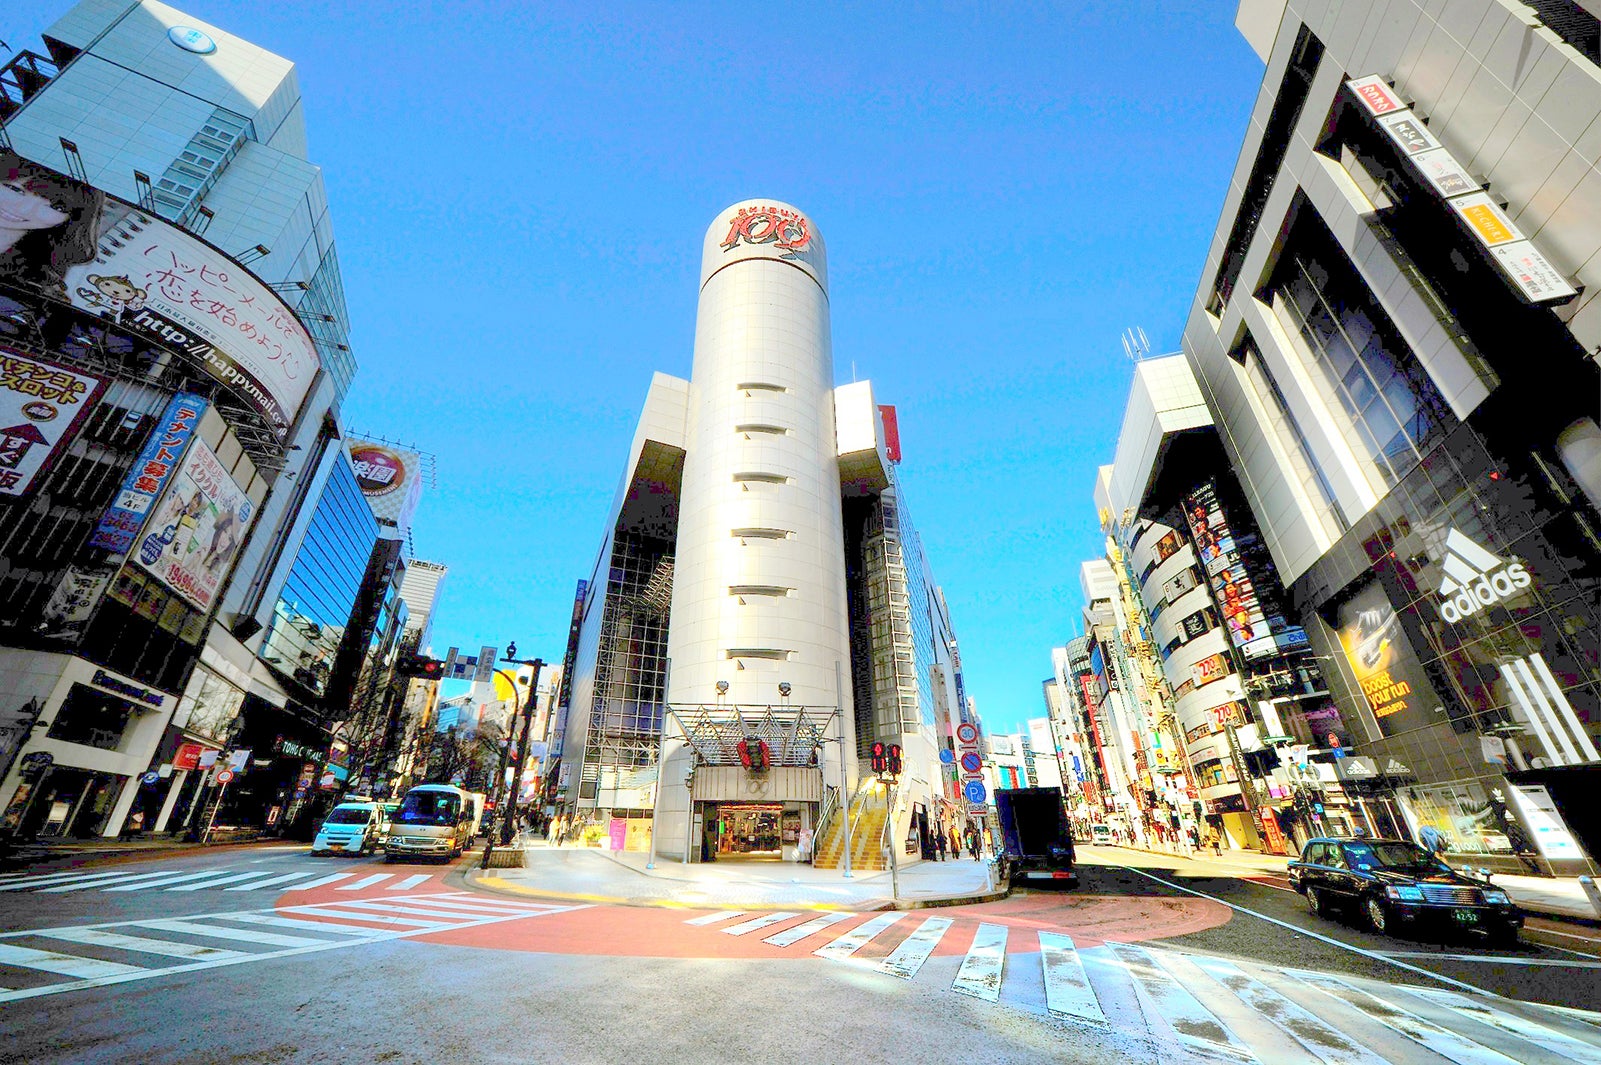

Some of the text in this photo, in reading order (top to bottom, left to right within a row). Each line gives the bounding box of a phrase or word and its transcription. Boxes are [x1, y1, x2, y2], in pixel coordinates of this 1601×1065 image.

[720, 212, 811, 249] 109
[133, 407, 197, 494] テナント募集
[122, 500, 141, 512] 4F
[1441, 563, 1532, 623] adidas
[1199, 658, 1216, 677] 270
[1363, 671, 1394, 695] boost
[1369, 688, 1392, 710] your
[1389, 681, 1411, 698] run
[1213, 705, 1232, 723] 270
[961, 728, 974, 739] 30
[970, 787, 979, 800] P
